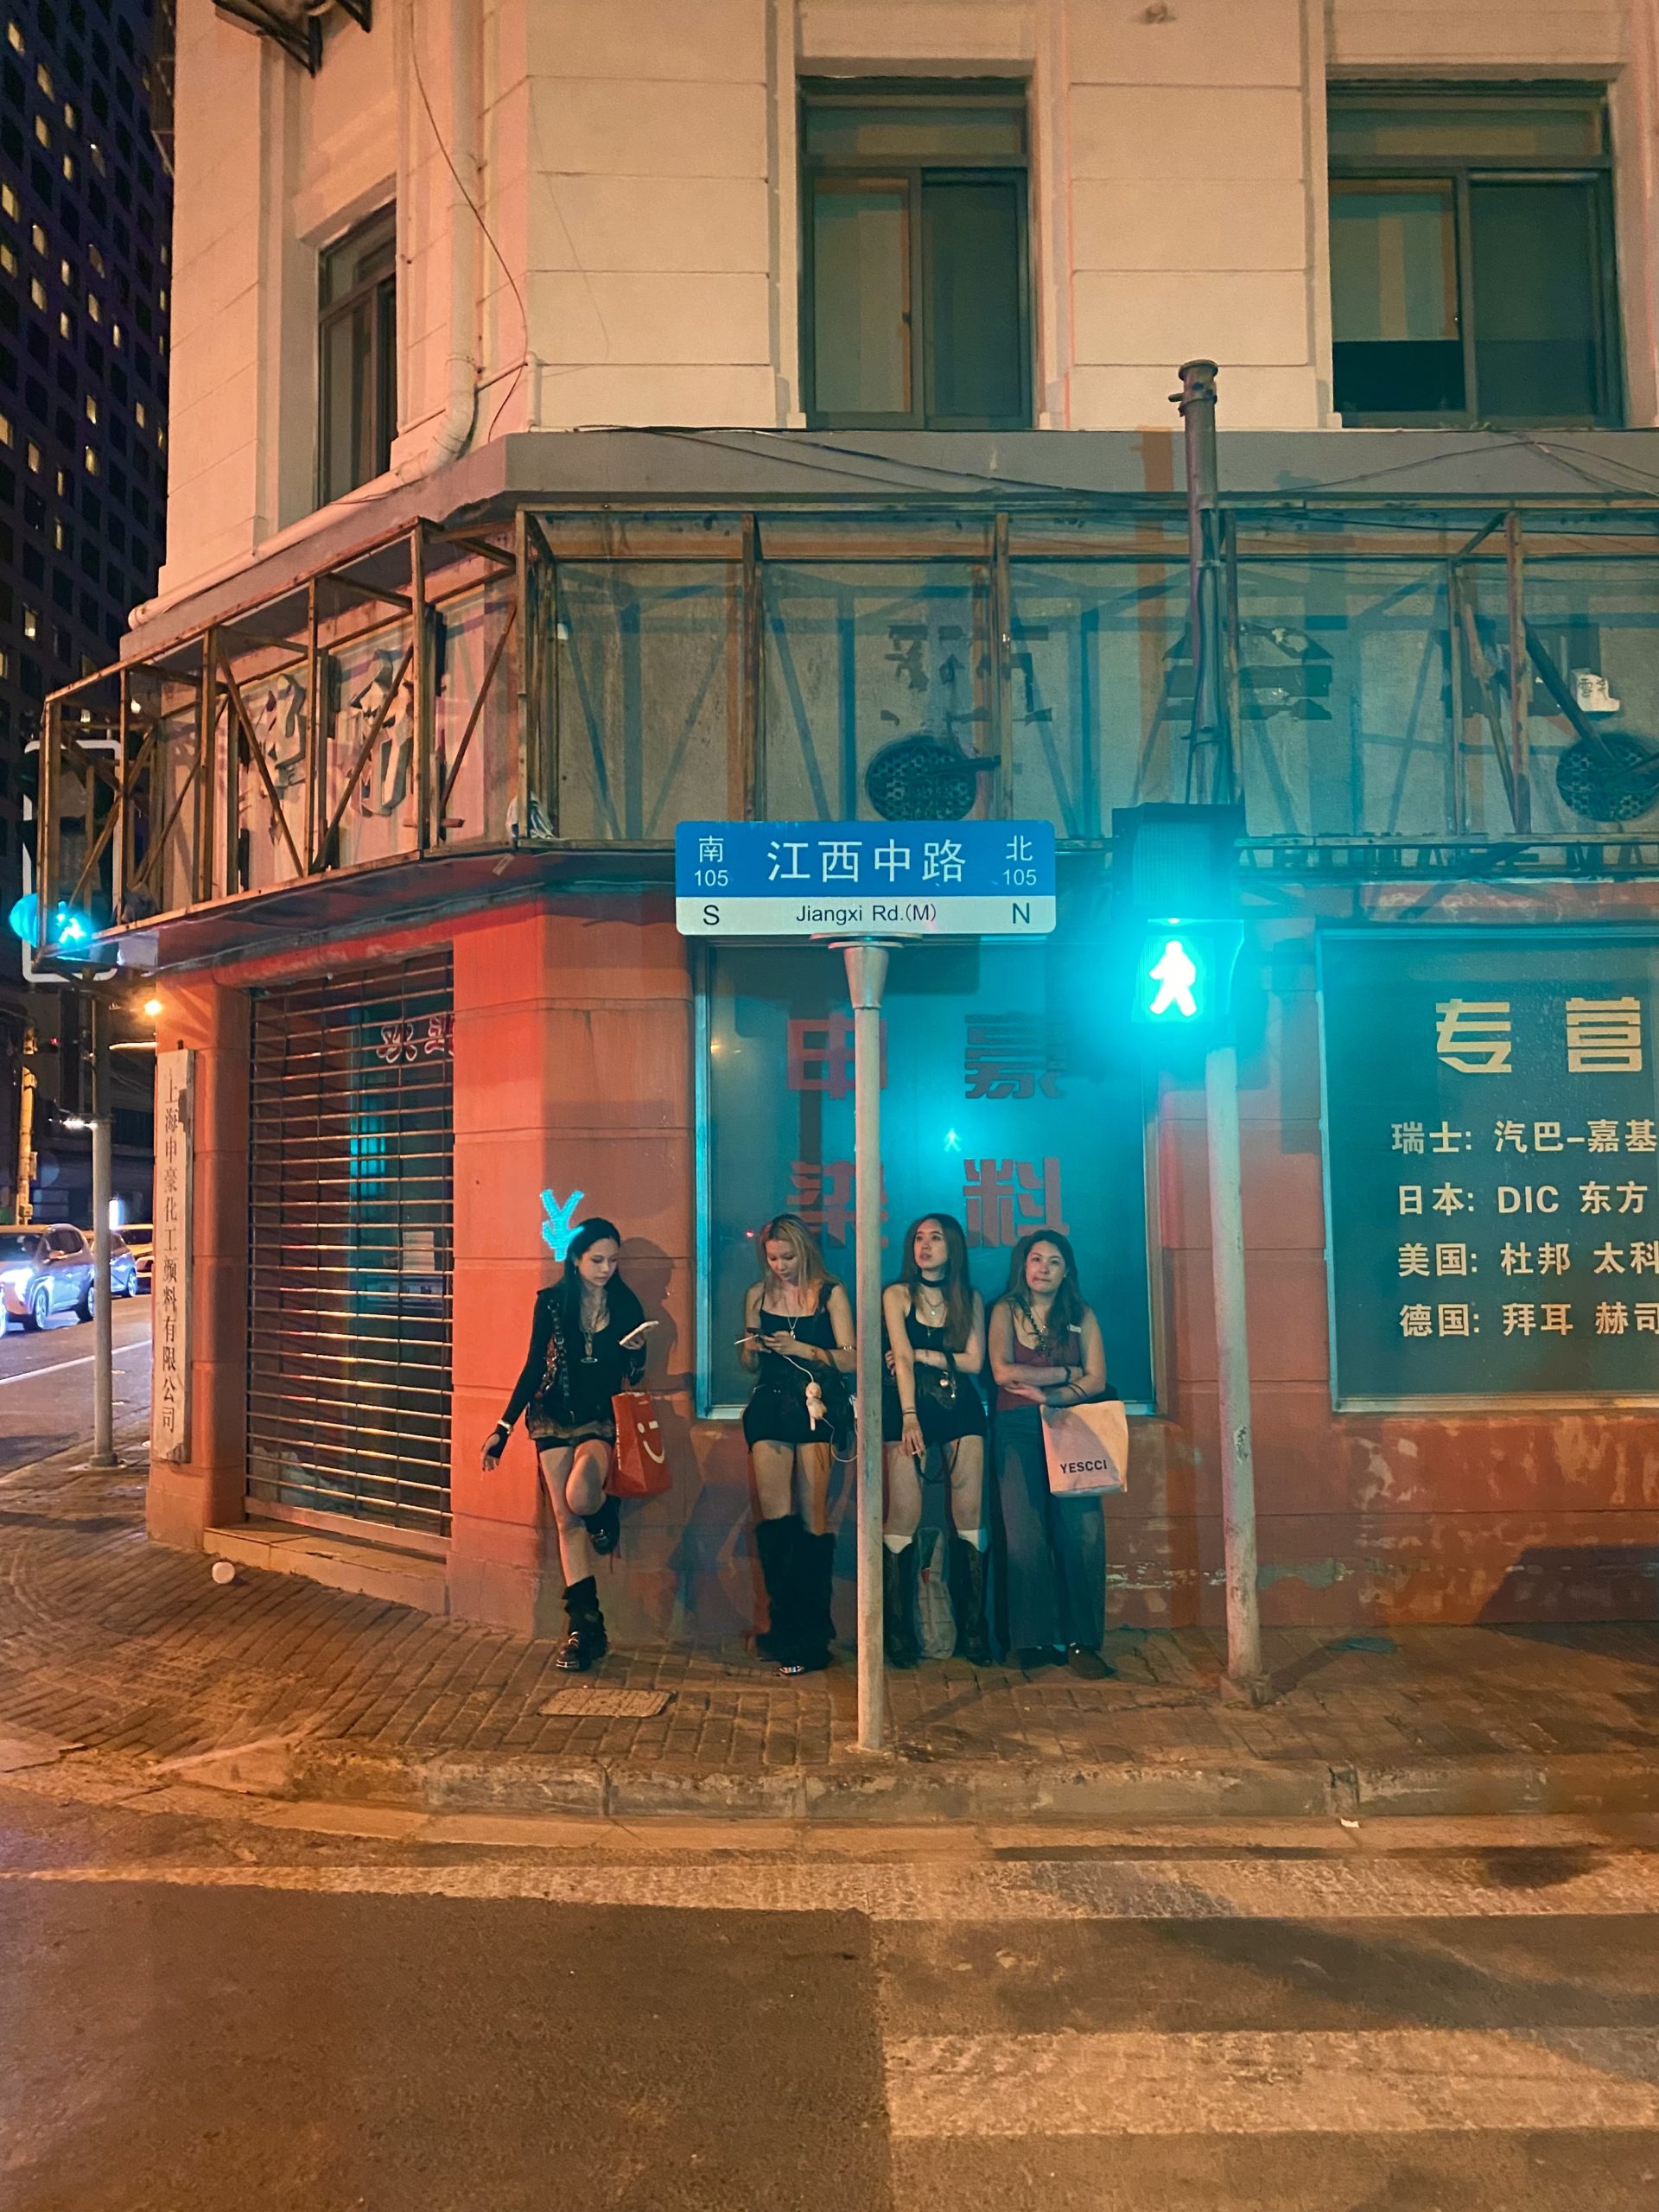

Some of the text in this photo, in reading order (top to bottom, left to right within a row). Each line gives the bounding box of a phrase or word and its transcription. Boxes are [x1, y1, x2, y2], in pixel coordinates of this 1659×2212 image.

[698, 835, 724, 862] 南
[766, 838, 966, 883] 江西中路
[1006, 835, 1033, 862] 北
[694, 870, 728, 887] 105
[1002, 869, 1037, 886] 105
[702, 905, 720, 926] S
[796, 903, 937, 926] Jiangxi Rd.(M)
[1013, 903, 1031, 924] N
[1497, 1185, 1559, 1214] DIC
[1579, 1180, 1649, 1215] 东方
[1500, 1242, 1571, 1276] 杜邦
[1502, 1302, 1573, 1336] 拜耳
[1059, 1459, 1108, 1474] YESCCI
